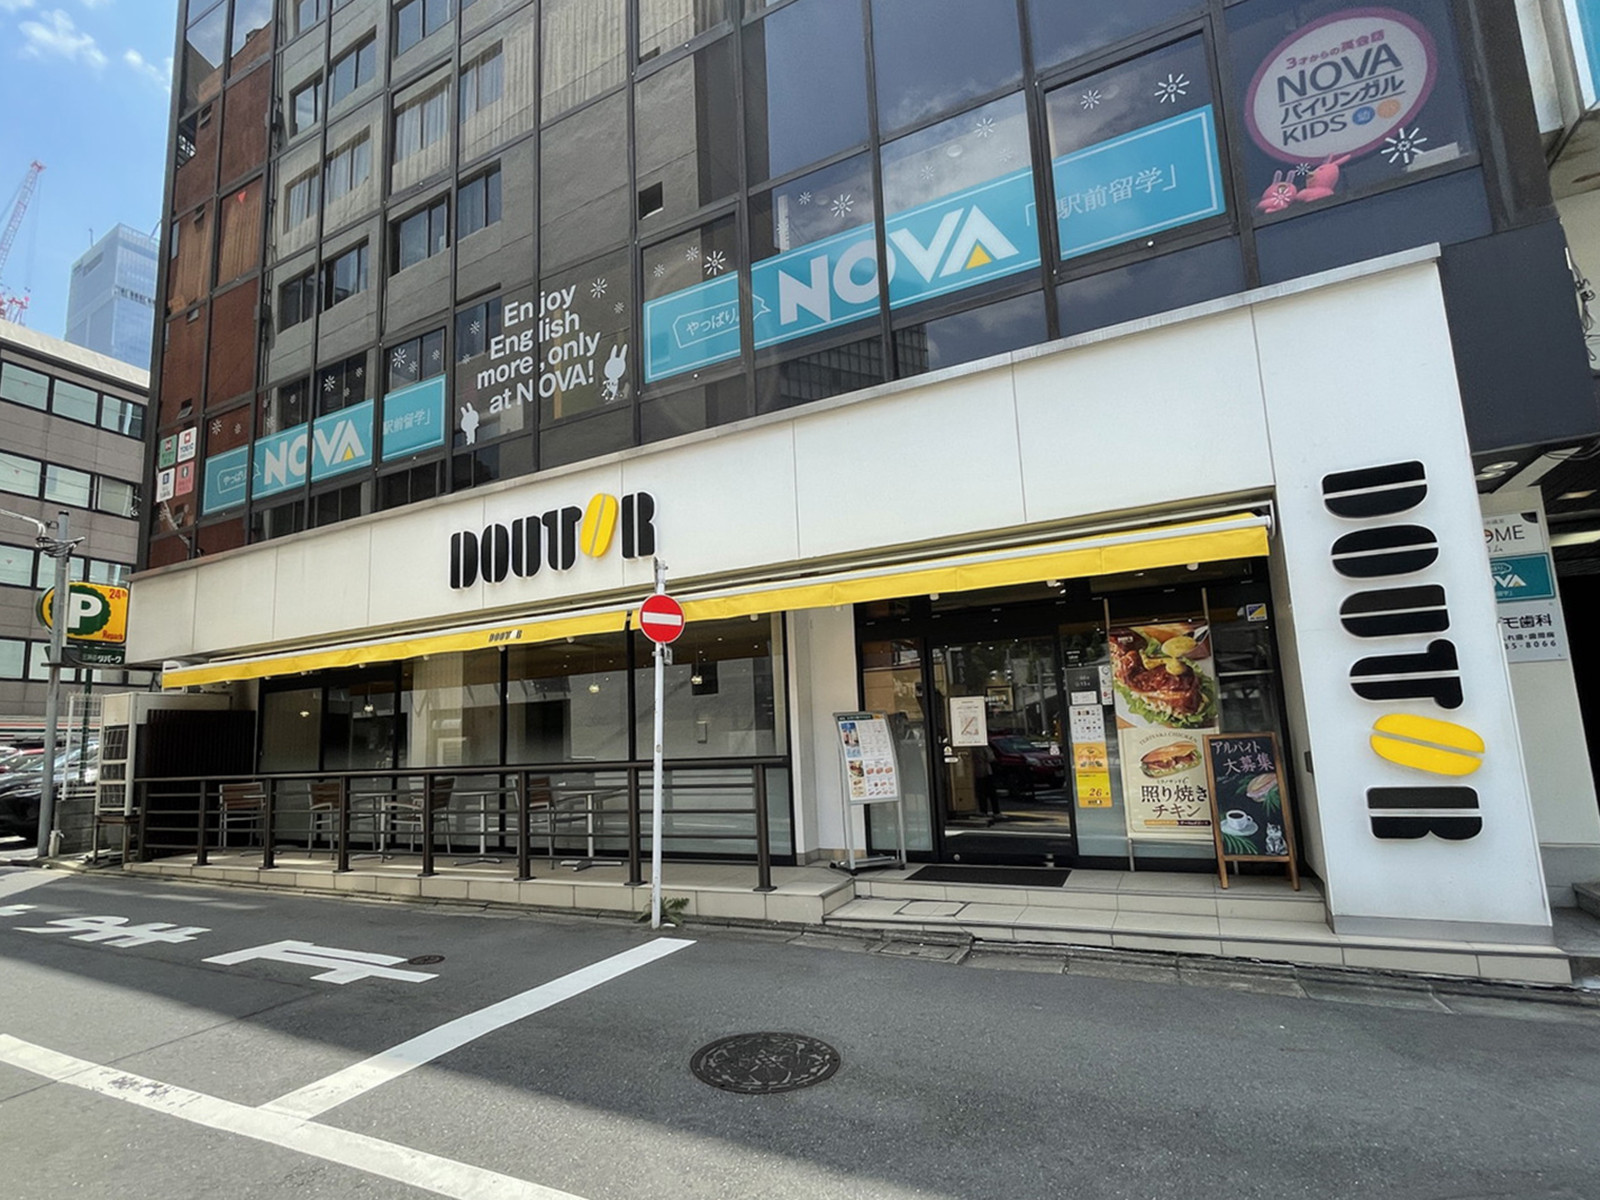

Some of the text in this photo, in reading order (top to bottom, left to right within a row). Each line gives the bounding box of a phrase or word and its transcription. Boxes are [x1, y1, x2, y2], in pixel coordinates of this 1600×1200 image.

[1286, 29, 1385, 70] 3才からの英会話
[1277, 43, 1402, 103] NOVA
[1281, 75, 1405, 125] バイリンガル
[1282, 113, 1348, 146] KIDS
[779, 204, 1019, 325] NOVA
[504, 284, 577, 328] Enjoy
[490, 310, 580, 361] English
[548, 332, 600, 366] only
[489, 359, 594, 414] at NOVA!
[264, 419, 366, 488] NOVA
[450, 491, 655, 590] DOUTOR
[1491, 574, 1527, 588] VA
[67, 592, 103, 629] P
[1499, 613, 1552, 629] モ歯科
[1320, 459, 1487, 842] DOUTOR
[1211, 740, 1261, 755] アルバイト
[1223, 752, 1275, 776] 大募集
[1141, 784, 1208, 803] 照り焼き
[1152, 803, 1201, 819] チキン
